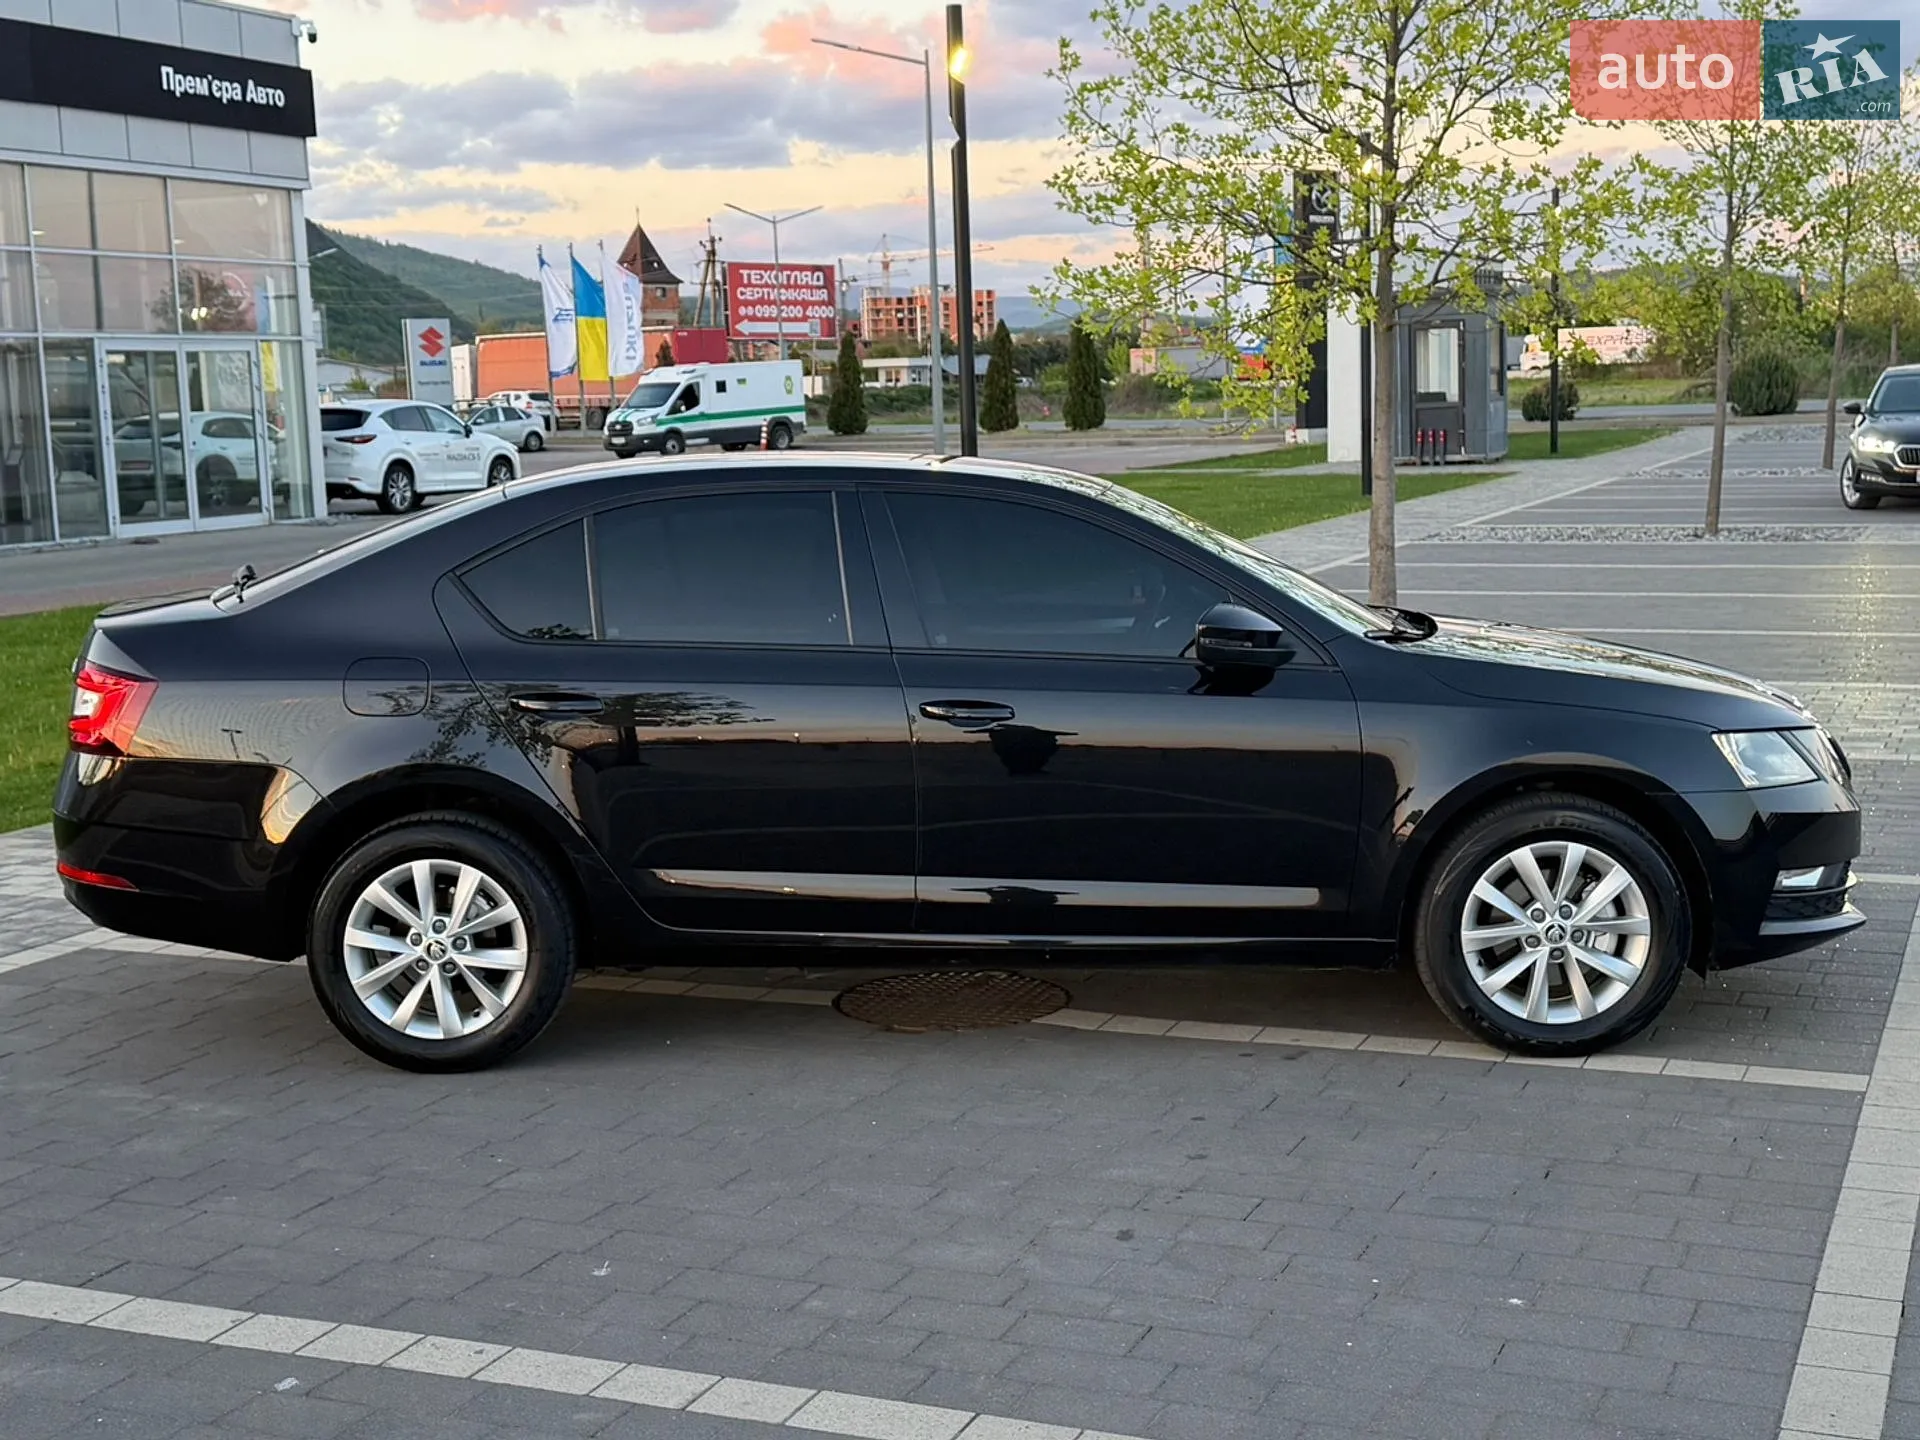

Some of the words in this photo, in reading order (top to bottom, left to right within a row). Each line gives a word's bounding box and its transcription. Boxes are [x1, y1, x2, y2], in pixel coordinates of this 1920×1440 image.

[160, 65, 242, 104] Прем'єра
[246, 79, 286, 108] Авто
[739, 269, 824, 285] ТЕХОГЛЯД
[736, 287, 828, 301] СЕРТИФІКАЦІЯ
[754, 304, 778, 317] 099
[780, 305, 803, 317] 200
[805, 305, 834, 317] 4000
